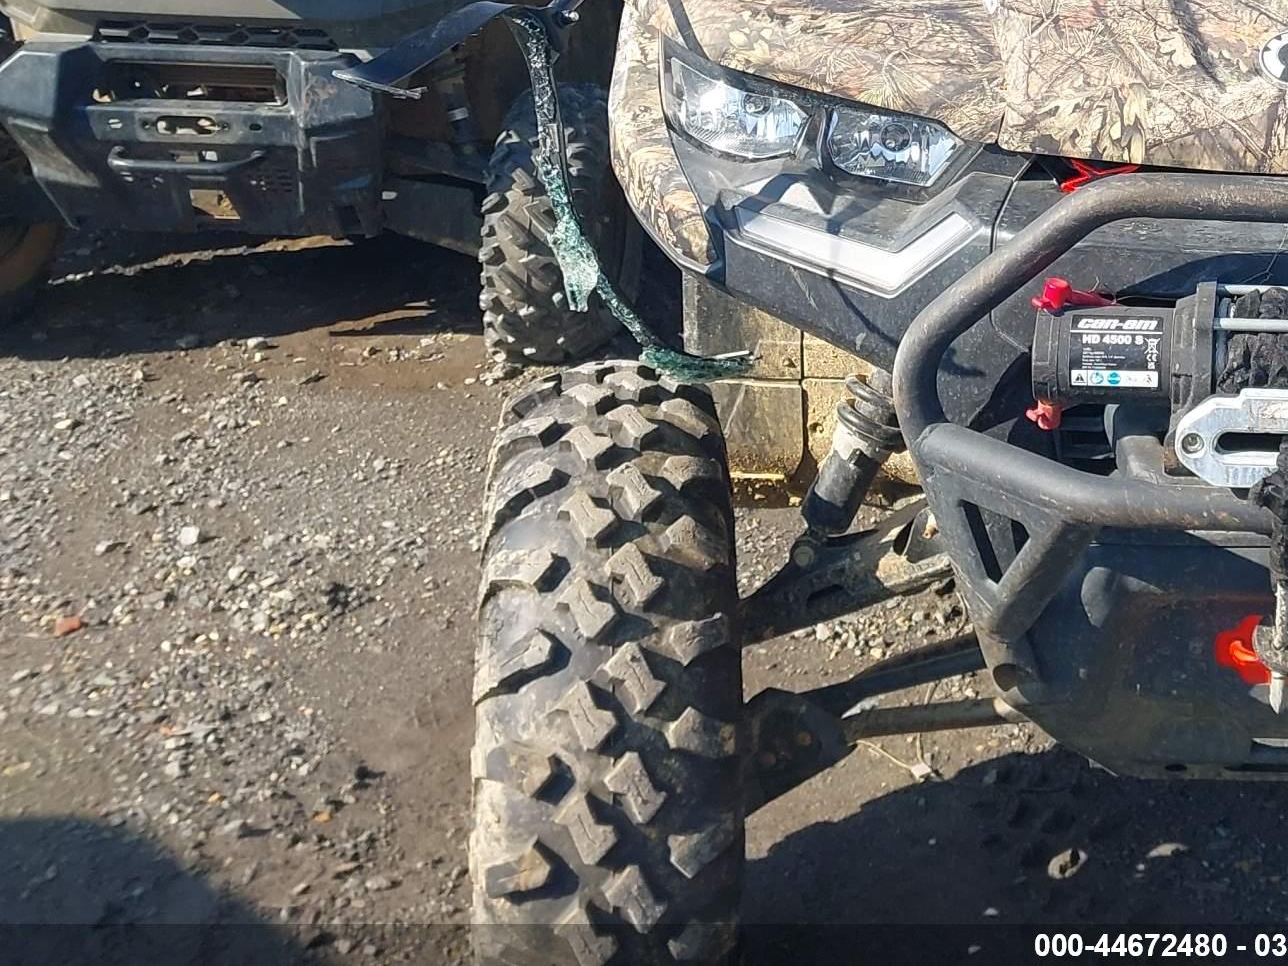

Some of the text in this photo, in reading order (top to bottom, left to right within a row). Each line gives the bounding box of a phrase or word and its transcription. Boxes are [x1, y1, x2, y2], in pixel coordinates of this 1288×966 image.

[1082, 334, 1145, 345] HD 4500 S
